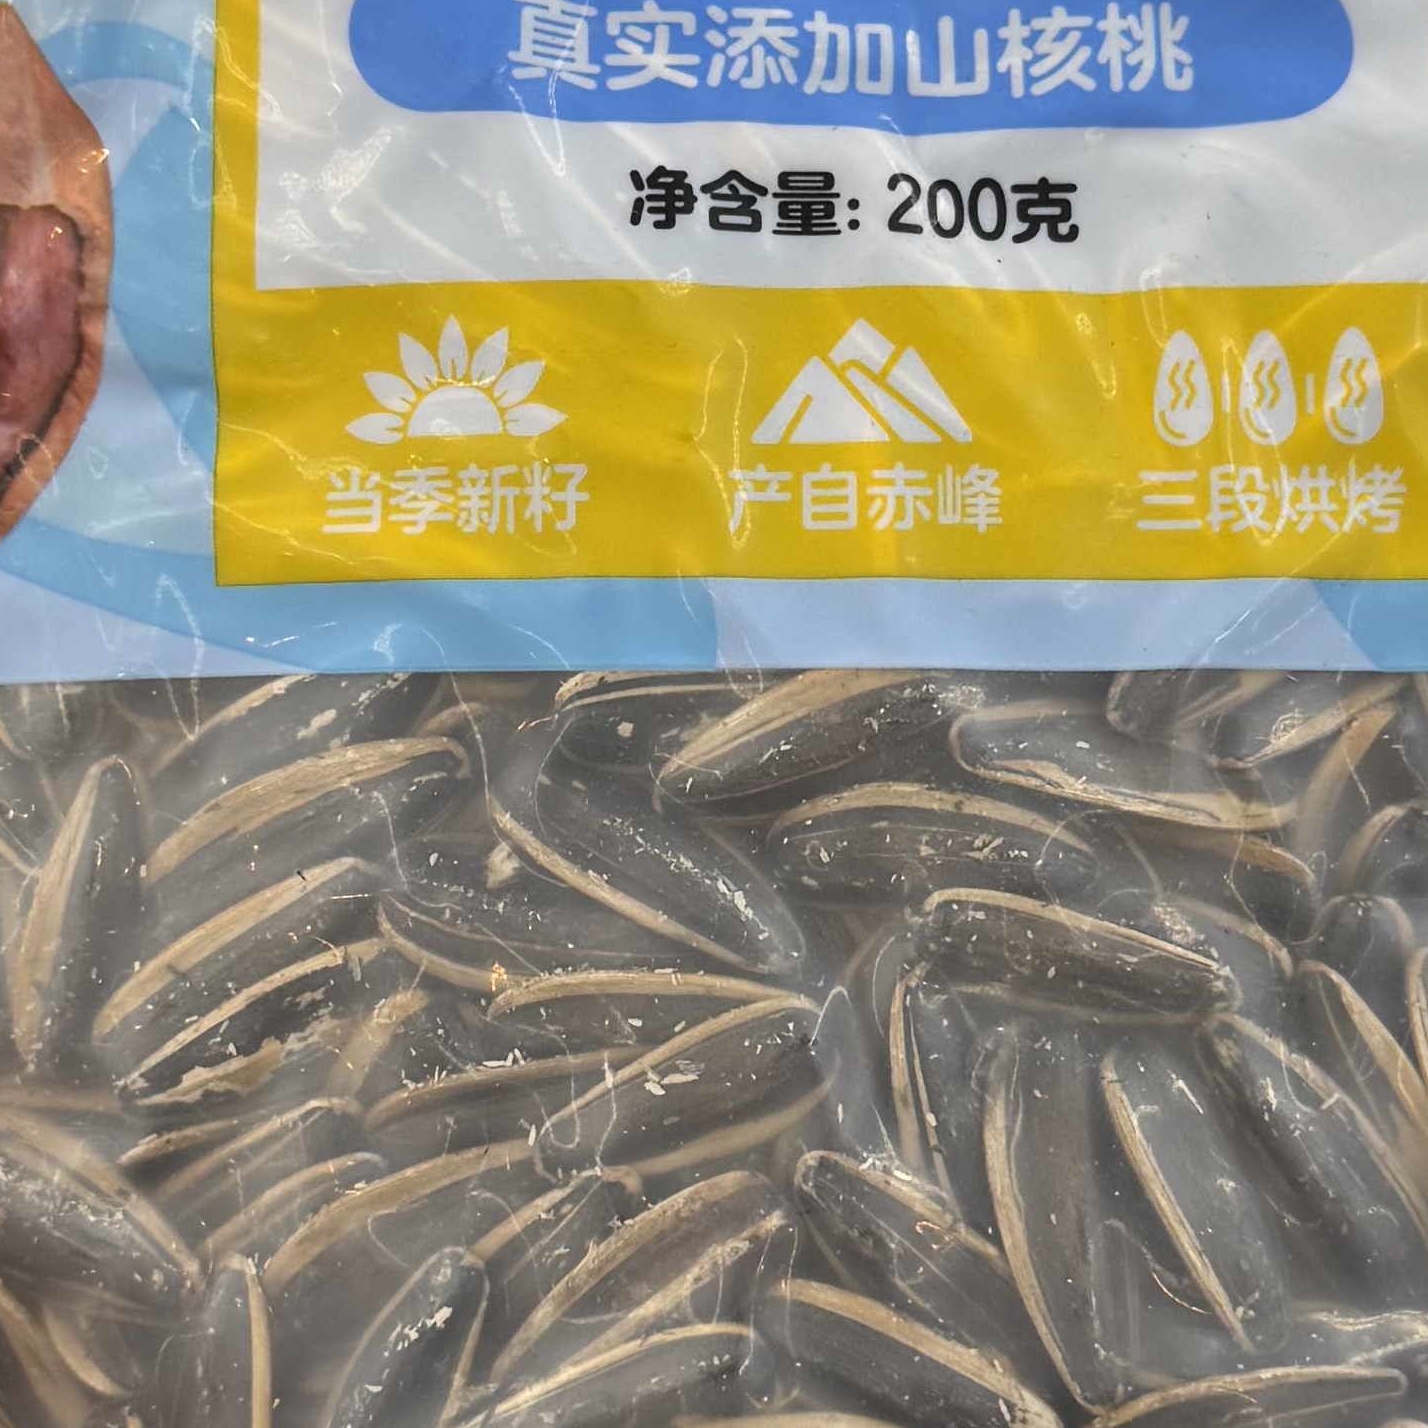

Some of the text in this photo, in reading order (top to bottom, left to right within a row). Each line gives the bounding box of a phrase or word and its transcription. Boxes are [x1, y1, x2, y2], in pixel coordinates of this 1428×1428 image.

[885, 174, 1080, 246] 200克
[322, 462, 591, 536] 当季新籽
[728, 464, 1004, 534] 产自赤峰
[1136, 466, 1408, 536] 三段烘烤
